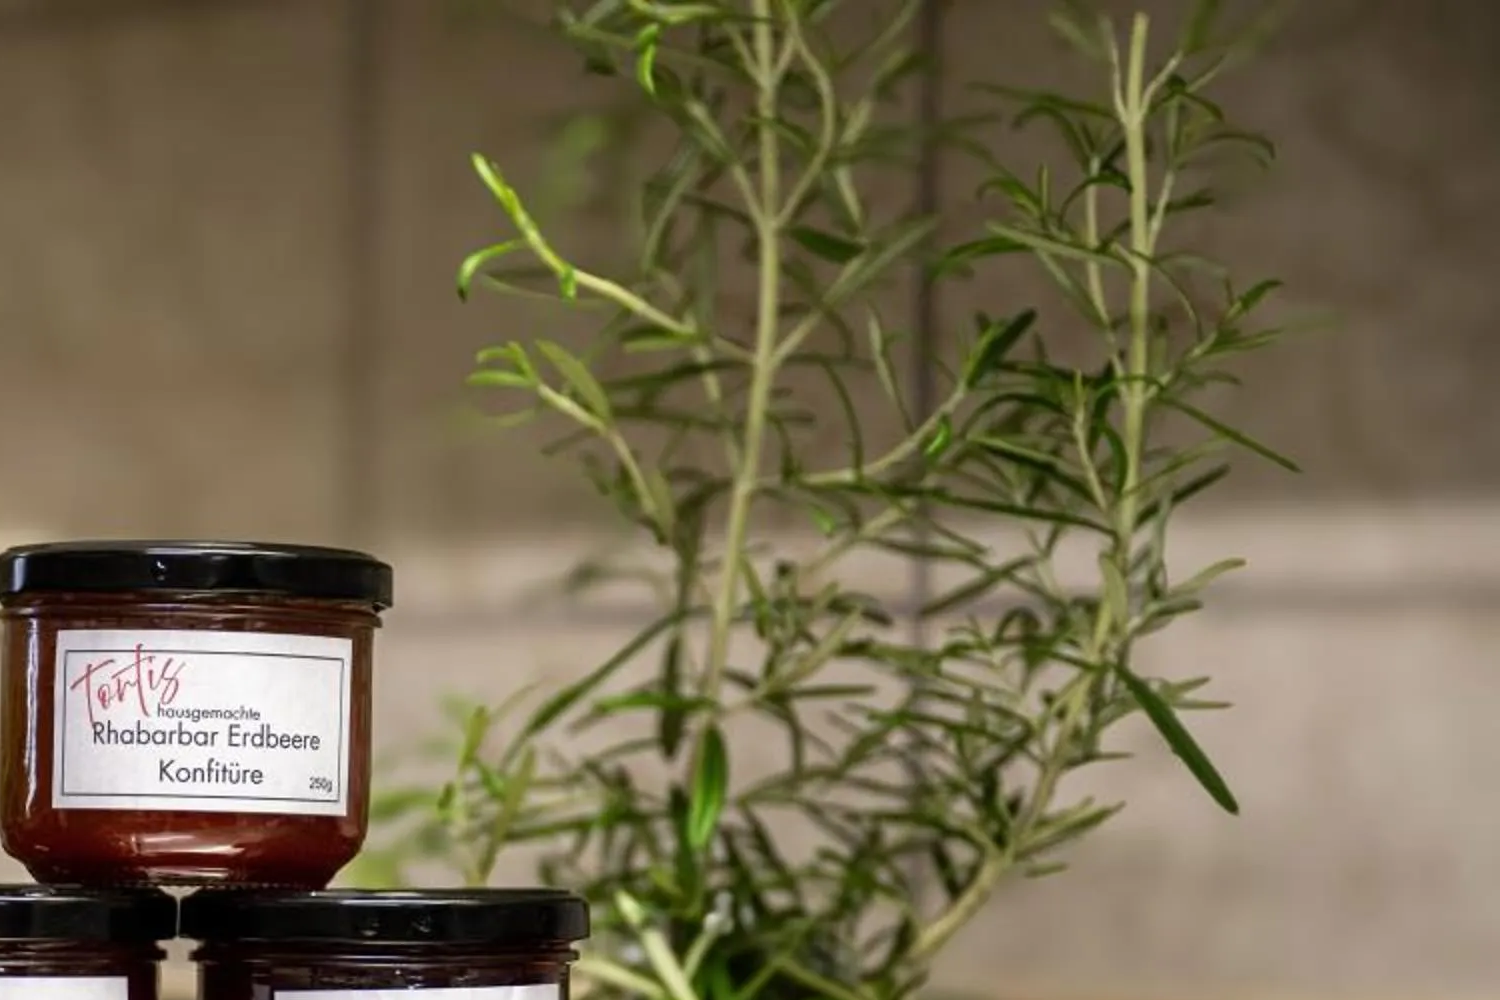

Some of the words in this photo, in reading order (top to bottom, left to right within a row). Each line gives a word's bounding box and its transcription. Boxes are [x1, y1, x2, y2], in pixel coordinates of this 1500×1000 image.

[157, 703, 261, 722] hausgemachte
[92, 720, 219, 747] Rhabarbar
[228, 724, 321, 750] Erdbeere
[158, 757, 264, 785] Konfitüre
[309, 776, 333, 793] 250g
